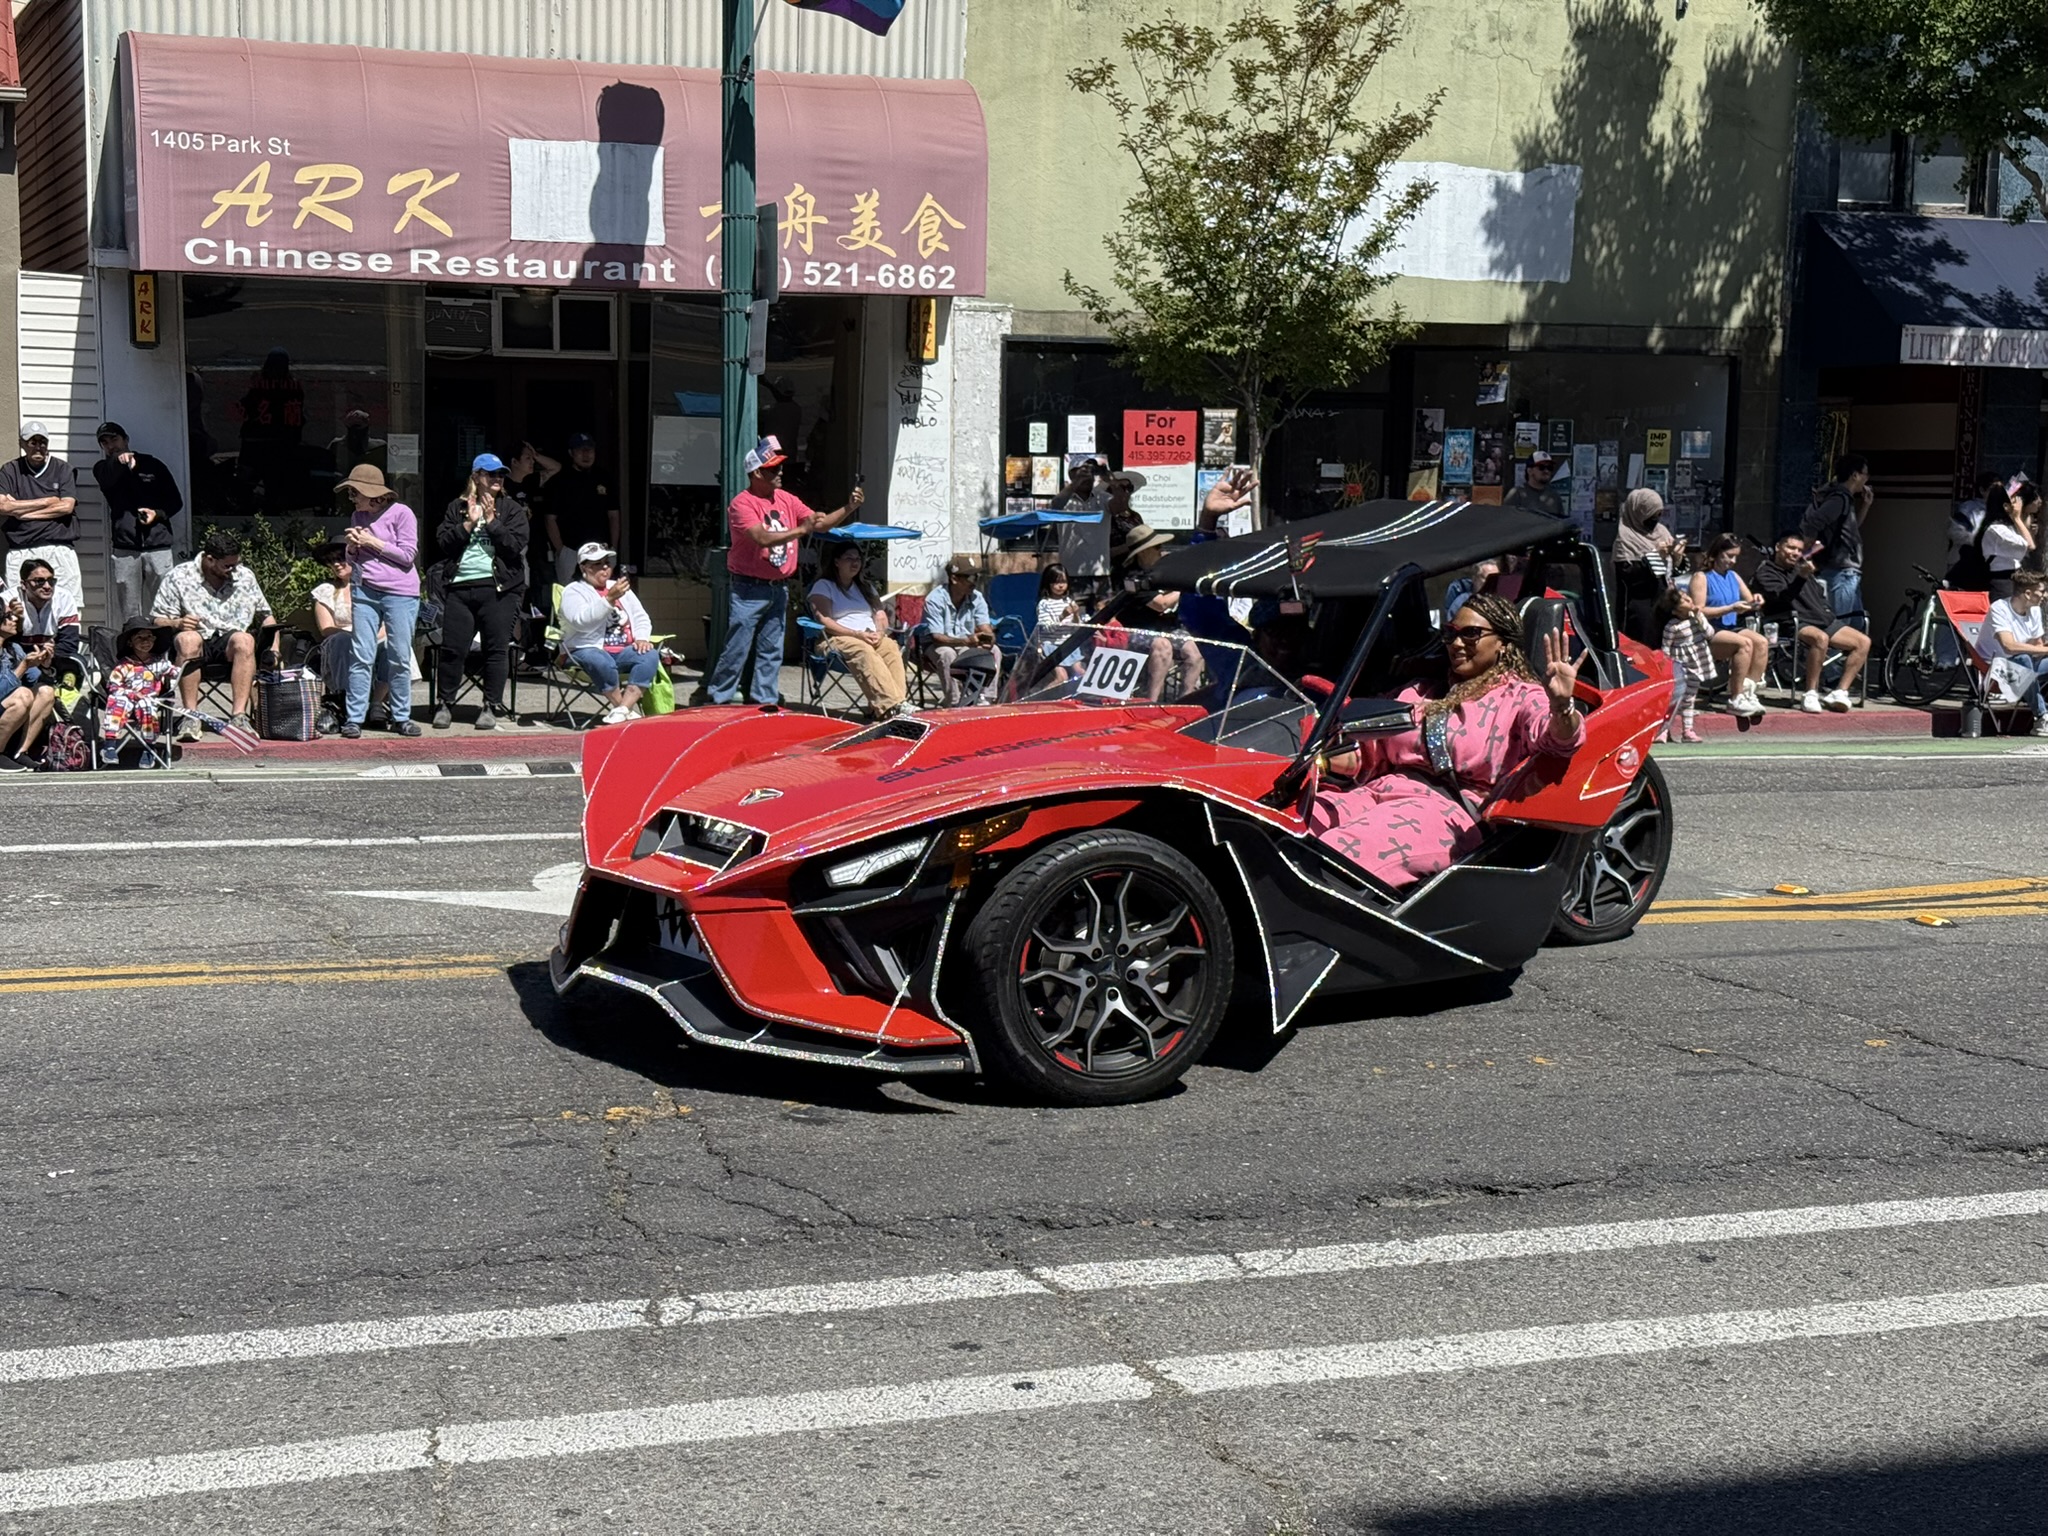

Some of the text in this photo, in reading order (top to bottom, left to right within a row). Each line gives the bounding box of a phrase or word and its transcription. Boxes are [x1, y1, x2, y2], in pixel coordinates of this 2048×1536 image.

[150, 129, 292, 156] 1405 Park St
[201, 160, 460, 238] ARK
[184, 237, 394, 274] Chinese
[409, 248, 677, 284] Restaurant
[803, 260, 956, 290] 521-6862
[137, 281, 152, 334] ARK
[1908, 332, 1967, 362] LITTLE
[1145, 413, 1177, 429] For
[1134, 431, 1186, 446] Lease
[1650, 432, 1668, 440] IMP
[1128, 450, 1192, 462] 415.395.7262
[1083, 652, 1139, 693] 109
